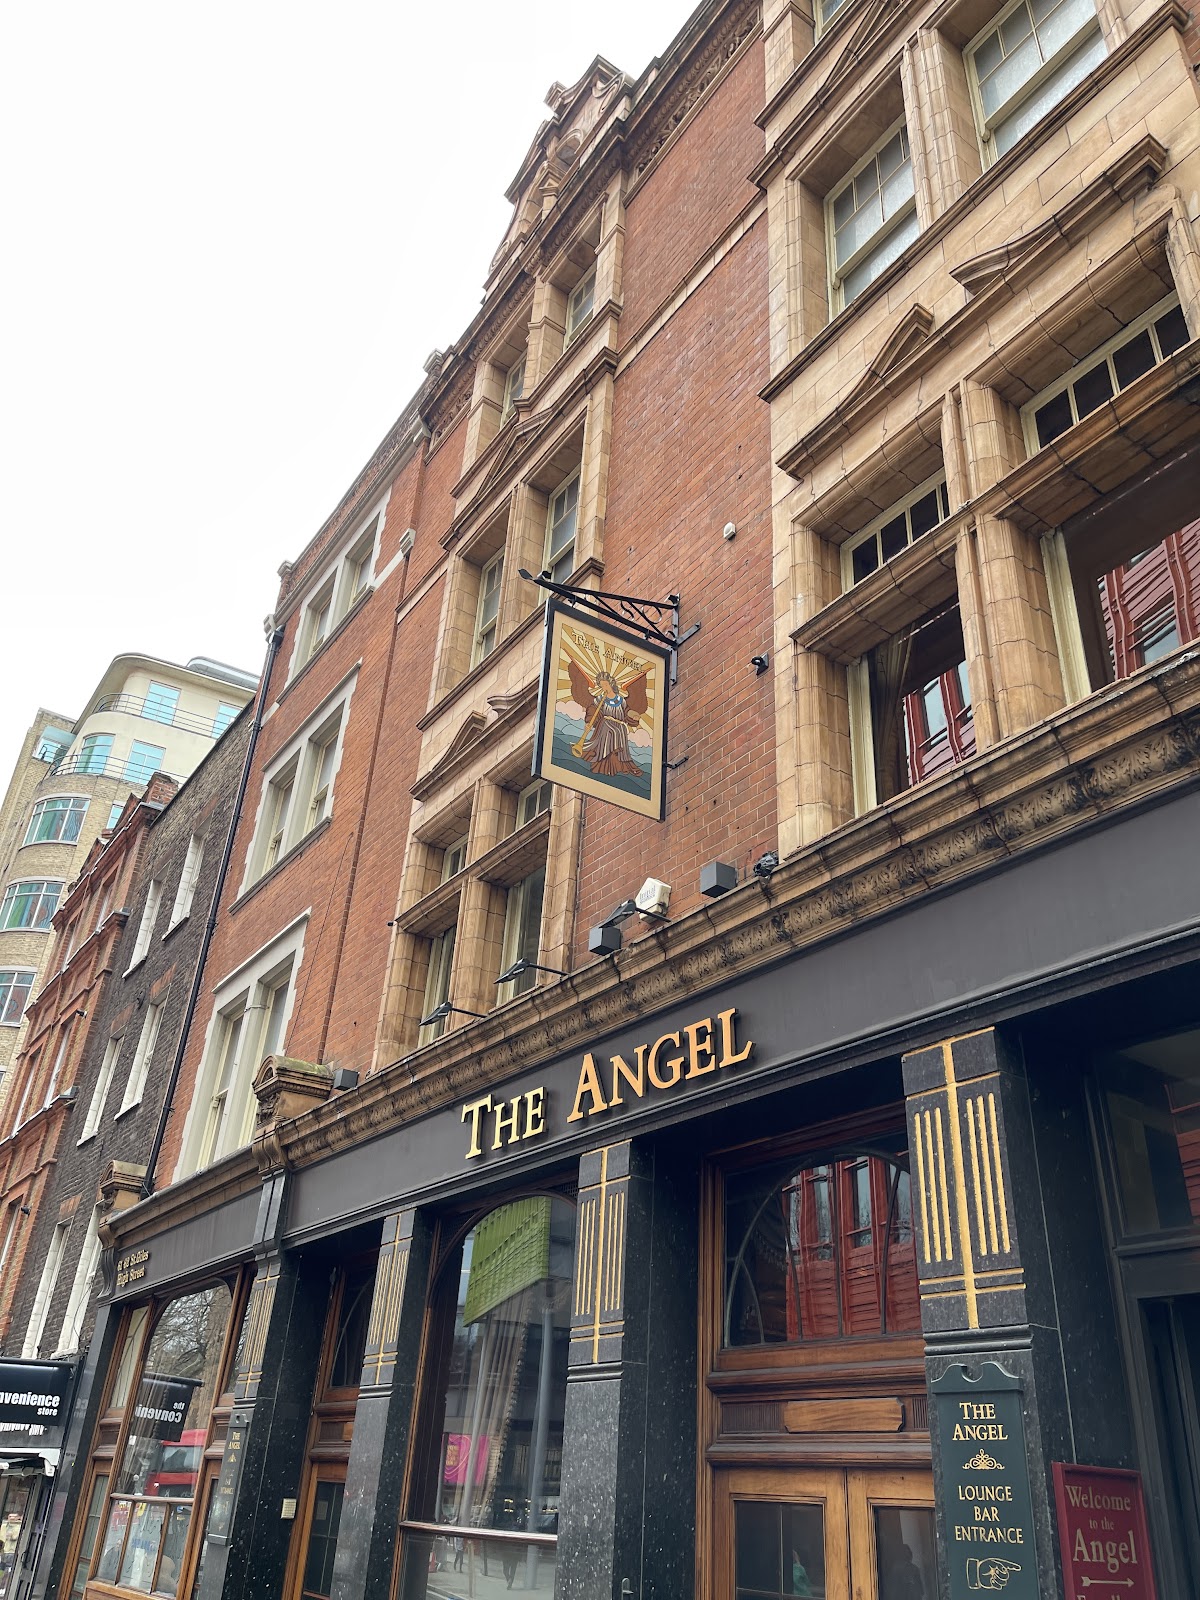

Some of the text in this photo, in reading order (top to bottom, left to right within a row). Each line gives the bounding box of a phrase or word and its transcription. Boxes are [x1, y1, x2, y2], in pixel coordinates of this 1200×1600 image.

[461, 1007, 755, 1160] THE ANGEL
[130, 1265, 144, 1281] Street
[37, 1407, 58, 1416] store
[959, 1402, 996, 1420] THE
[952, 1424, 1008, 1441] ANGEL
[958, 1485, 1013, 1502] LOUNGE
[1065, 1485, 1131, 1511] Welcome
[973, 1506, 1000, 1522] BAR
[1089, 1516, 1114, 1530] to the
[955, 1526, 1024, 1544] ENTRANCE
[1072, 1528, 1138, 1573] Angel
